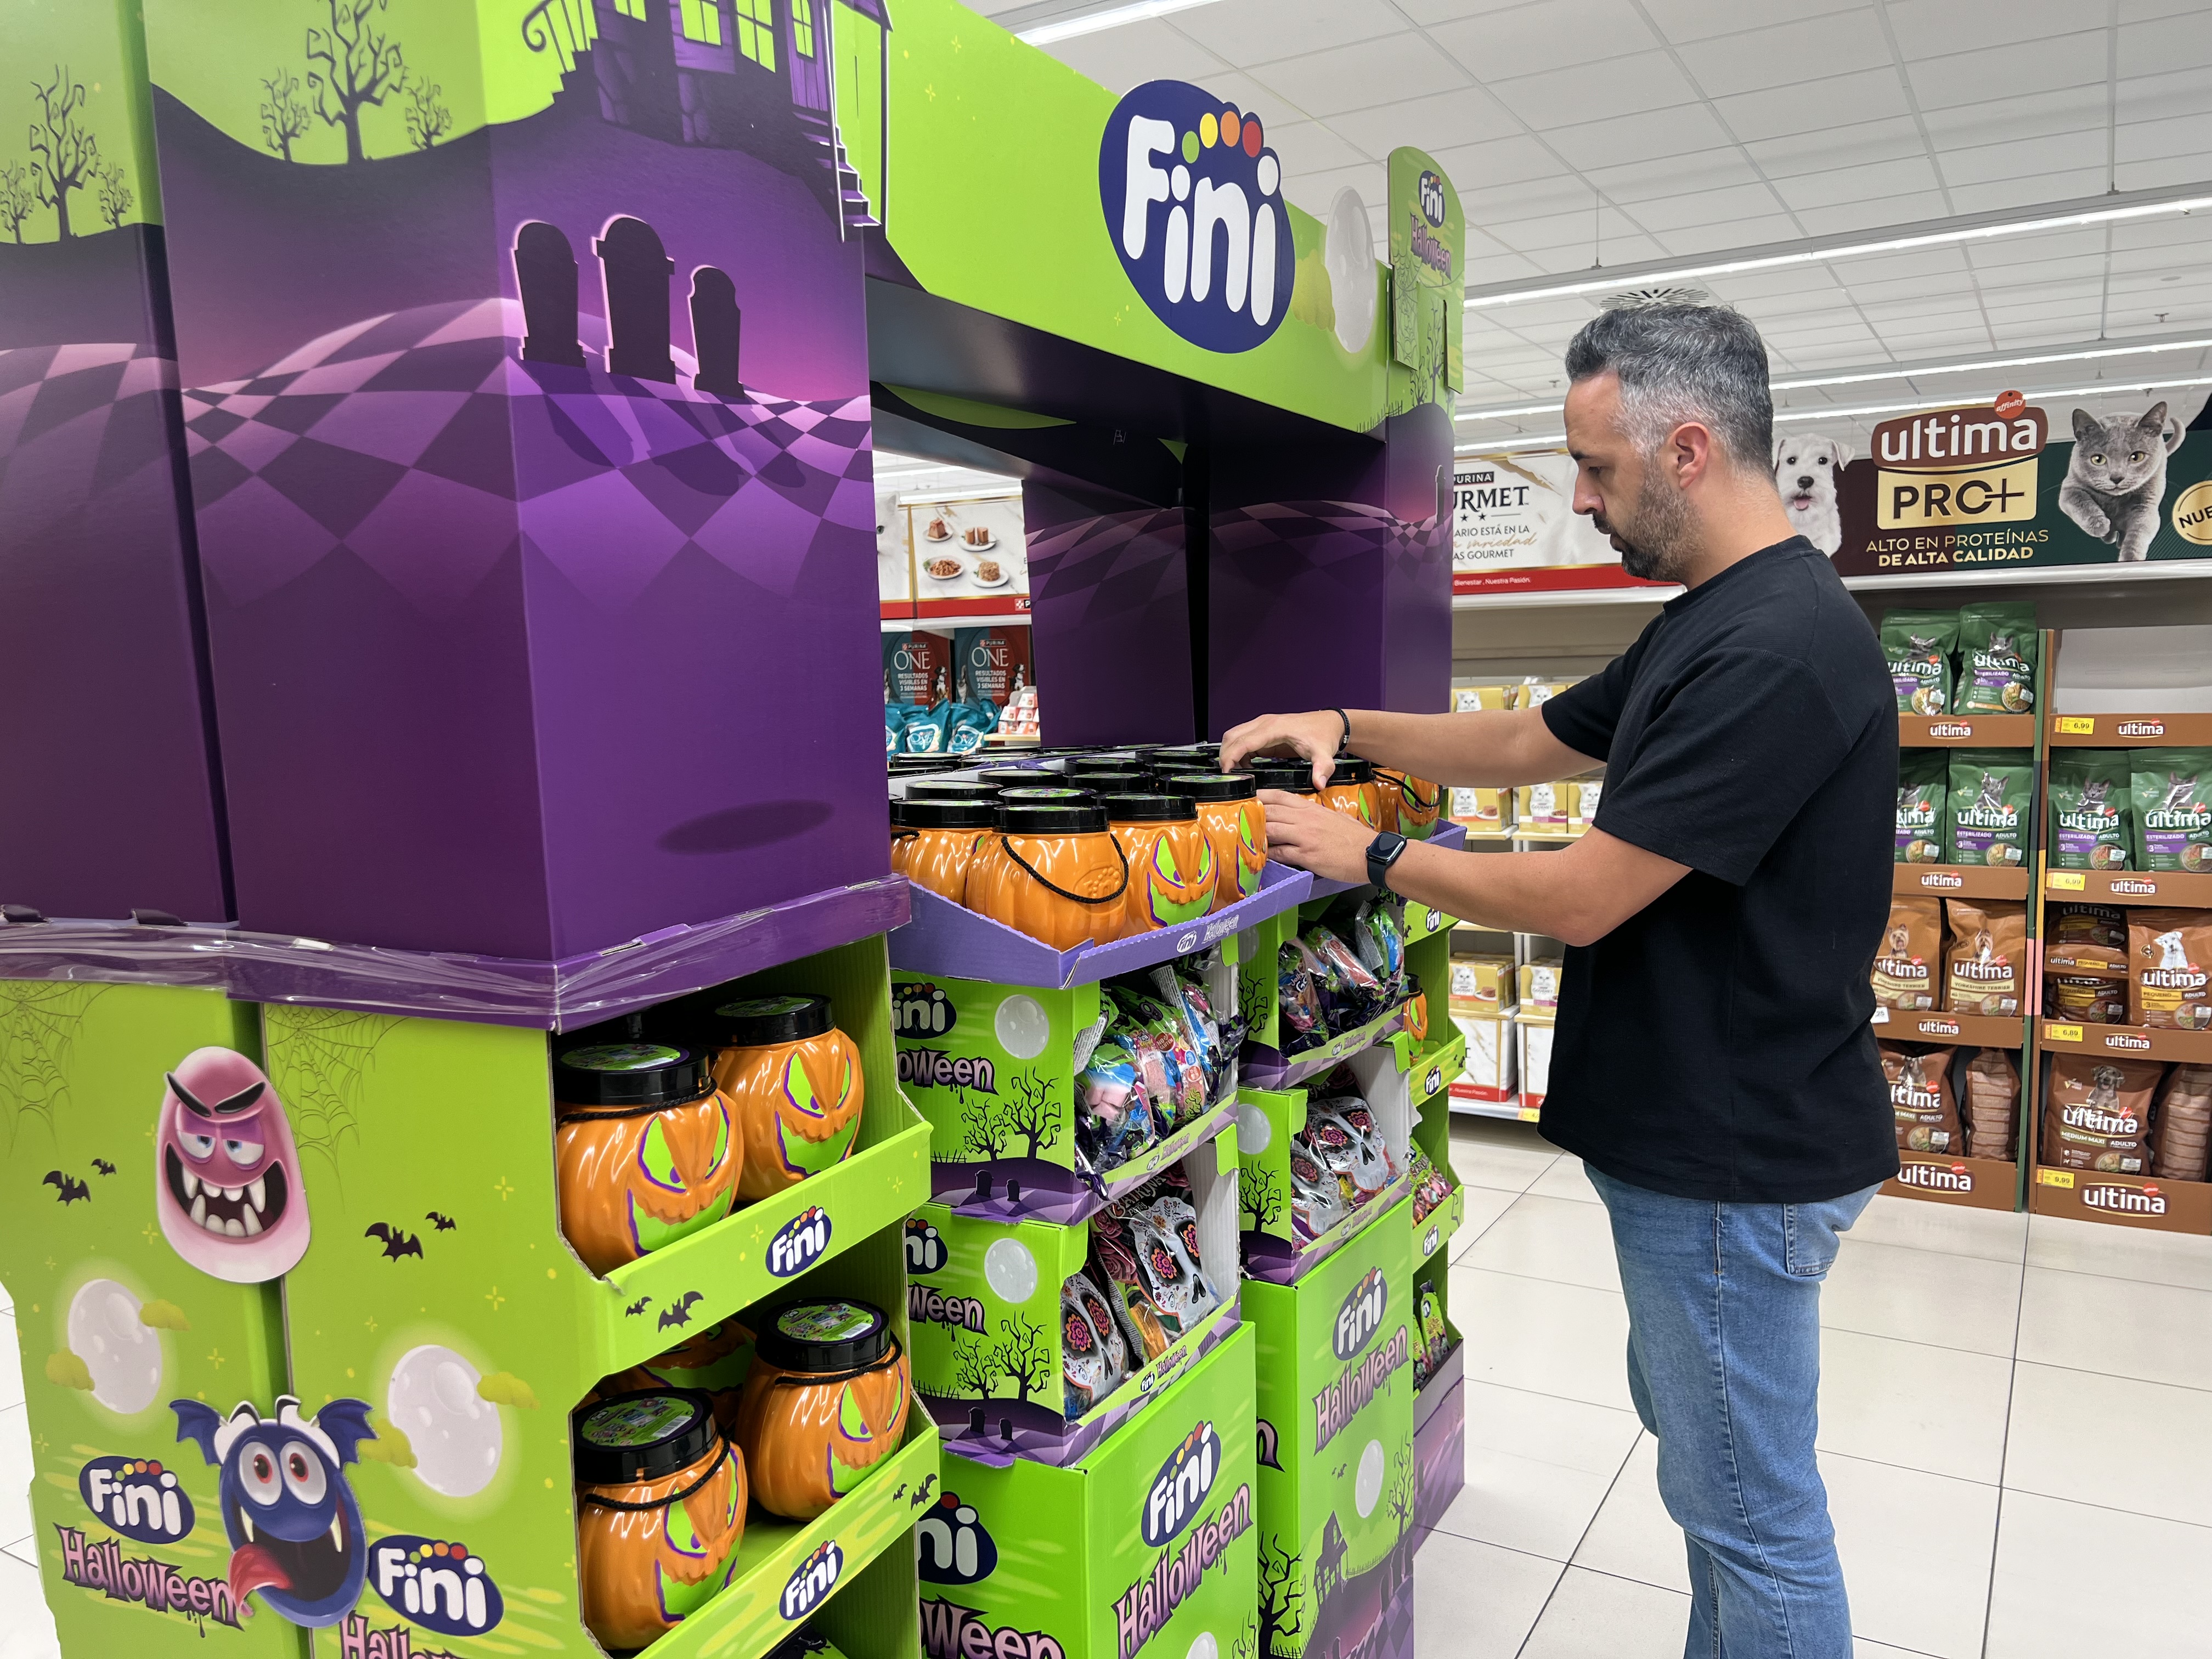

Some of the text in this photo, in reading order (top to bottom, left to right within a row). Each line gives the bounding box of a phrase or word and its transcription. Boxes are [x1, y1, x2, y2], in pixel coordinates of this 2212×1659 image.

[1420, 177, 1443, 223] Fini
[1122, 115, 1279, 326] Fini
[1996, 399, 2024, 412] affinity
[1881, 414, 2038, 462] ultima
[1453, 486, 1530, 512] RMET
[2179, 506, 2212, 529] NUE
[1454, 524, 1530, 537] ARIO ESTÁ EN LA
[1866, 528, 2049, 552] ALTO EN PROTEÍNAS
[1453, 549, 1514, 560] AS GOURMET
[1878, 546, 2034, 567] DE ALTA CALIDAD
[894, 650, 932, 670] ONE
[971, 646, 1009, 668] ONE
[1930, 724, 1971, 737] ultima
[2119, 723, 2164, 736] ultima
[1897, 807, 1936, 825] tima
[1957, 809, 2018, 826] ultima
[2059, 812, 2119, 831] ultima
[2145, 810, 2211, 828] ultima
[1921, 874, 1962, 887] ultima
[2111, 881, 2156, 894] ultima
[1954, 961, 2012, 979] ultima
[2050, 957, 2074, 965] ultima
[2143, 970, 2207, 987] ultima
[893, 990, 945, 1032] ini
[1918, 1021, 1959, 1035] ultima
[2106, 1036, 2150, 1049] ultima
[1891, 1084, 1941, 1108] ltima
[2063, 1105, 2138, 1134] ultima
[2061, 1131, 2137, 1148] MEDIUM MAXI ADULTO
[1897, 1165, 1971, 1191] ultima
[2083, 1187, 2165, 1214] ultima
[772, 1207, 824, 1272] Fini
[905, 1226, 938, 1269] ni
[1338, 1267, 1383, 1355] Fini
[1150, 1422, 1212, 1541] Fini
[89, 1469, 182, 1536] Fini
[918, 1507, 978, 1577] ni
[377, 1547, 488, 1628] Fini
[786, 1540, 836, 1617] Fini
